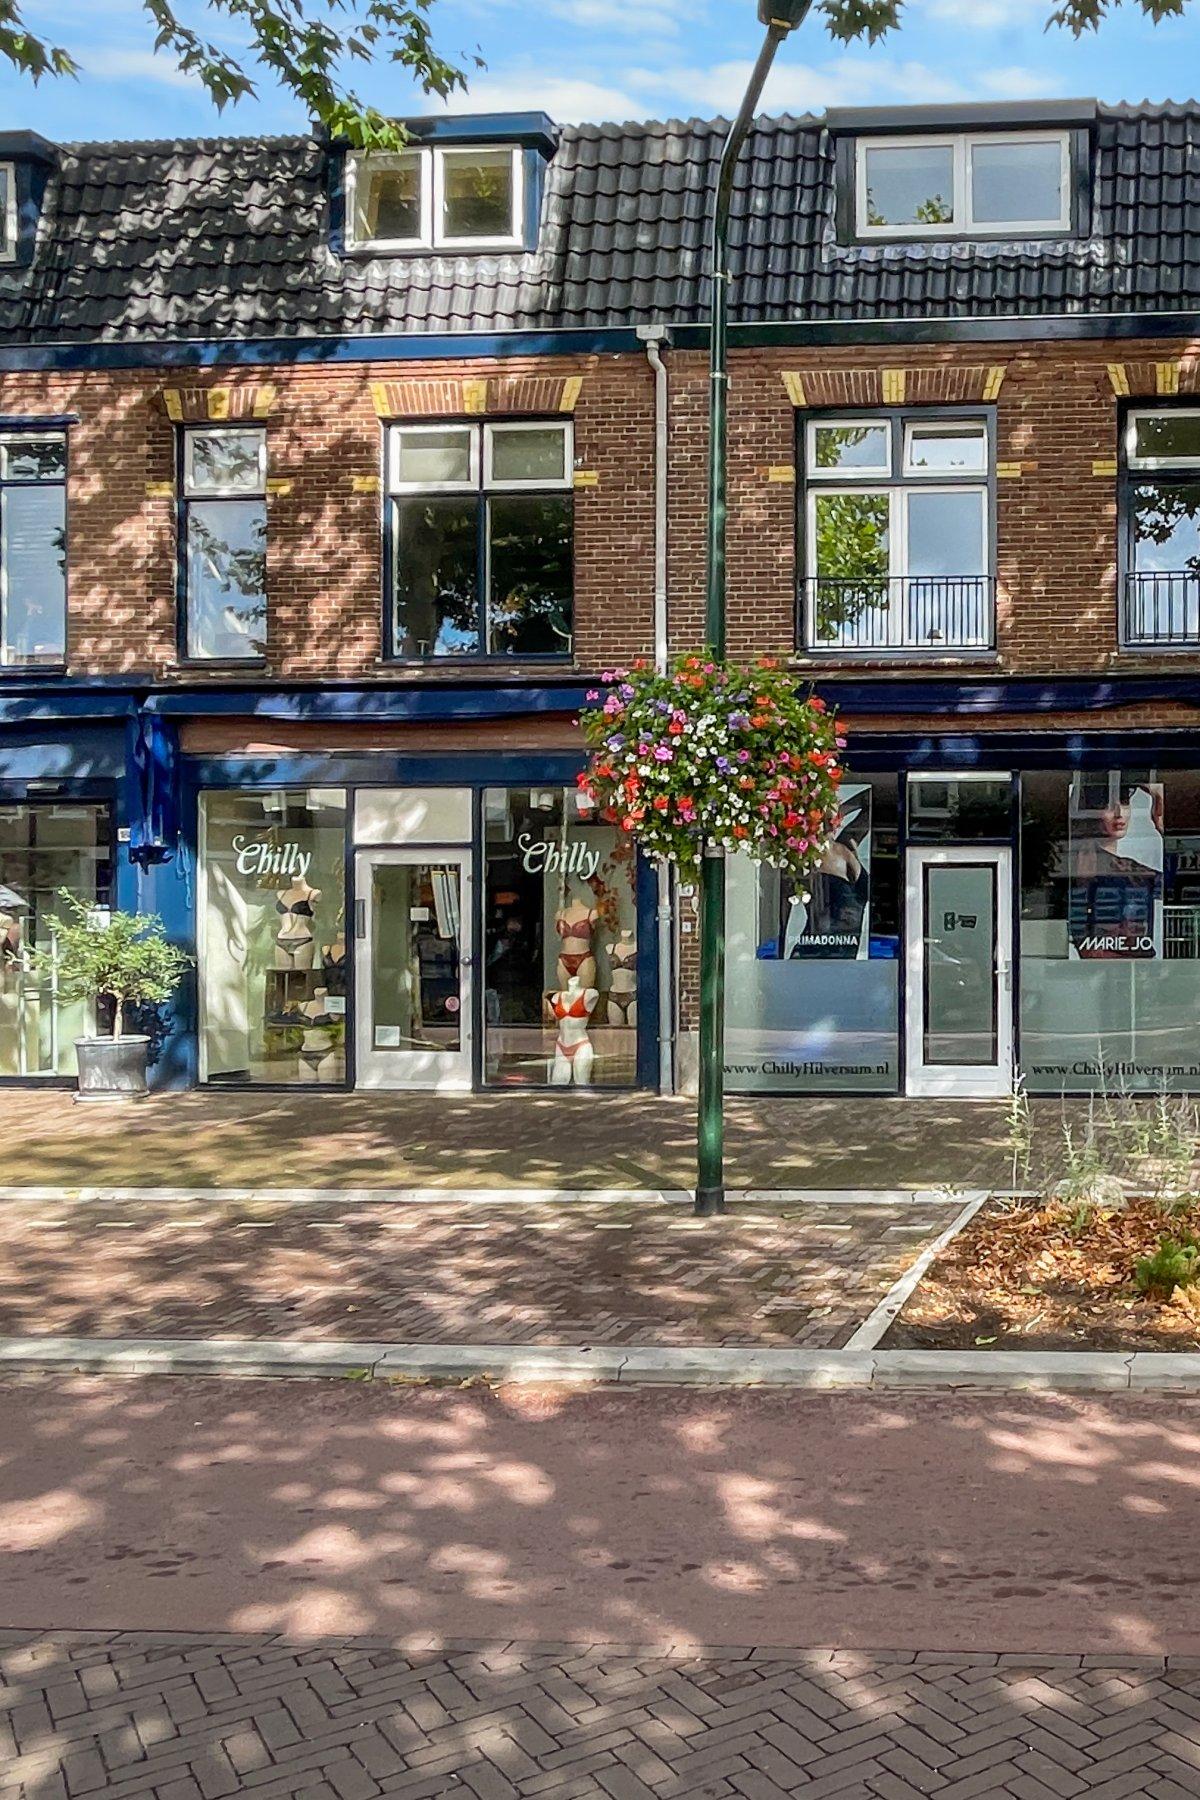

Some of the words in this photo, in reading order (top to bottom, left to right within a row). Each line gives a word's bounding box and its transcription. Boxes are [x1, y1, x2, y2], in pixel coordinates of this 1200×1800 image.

[232, 834, 312, 879] Chilly
[518, 832, 600, 881] Chilly
[1079, 936, 1130, 951] MARIE
[1130, 936, 1153, 951] JO
